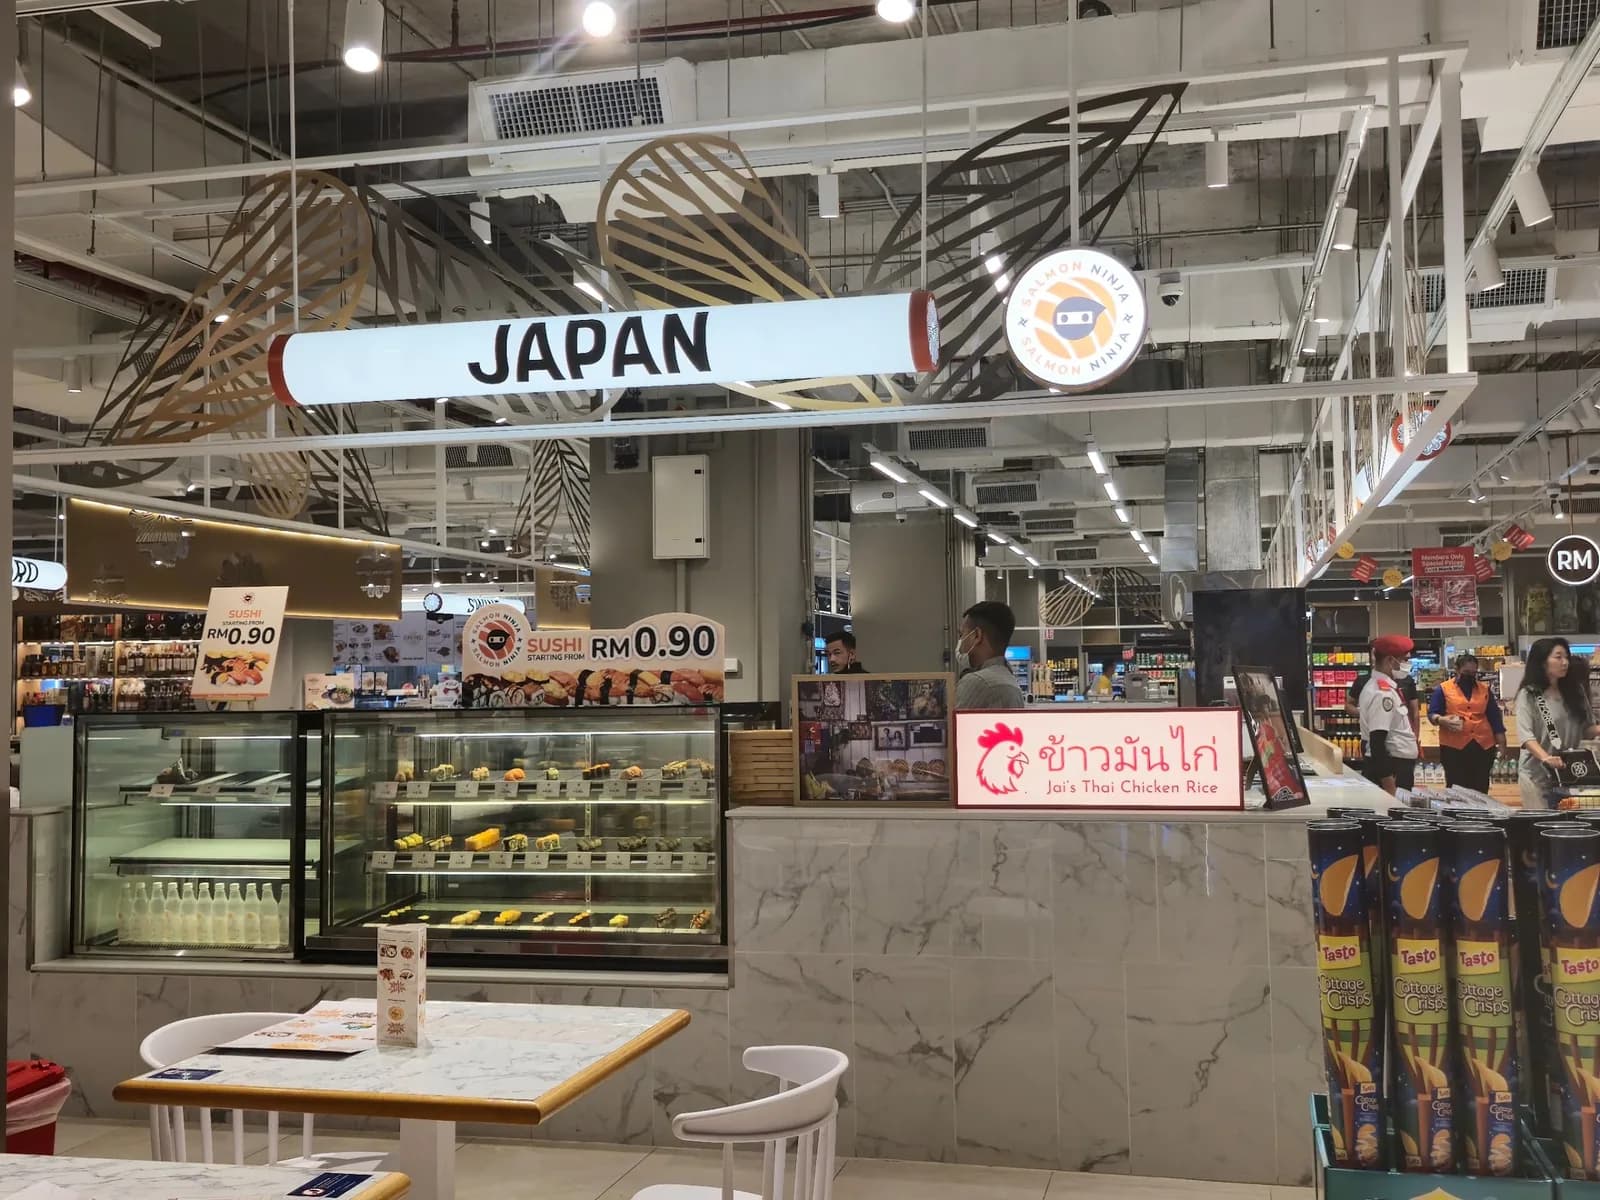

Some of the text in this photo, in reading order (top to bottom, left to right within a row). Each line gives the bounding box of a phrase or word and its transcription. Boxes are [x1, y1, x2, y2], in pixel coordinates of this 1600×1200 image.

[1022, 261, 1130, 307] SALMON NINJA
[468, 312, 711, 384] JAPAN
[1022, 332, 1131, 376] SALMON NINJA
[1557, 549, 1592, 571] RM
[228, 609, 262, 619] SUSHI
[472, 612, 521, 634] SALMON NINJA
[207, 627, 276, 645] RM0.90
[527, 637, 582, 653] SUSHI
[591, 625, 716, 659] RM0.90
[472, 646, 521, 667] SALMON NINJA
[527, 653, 586, 662] STARTING FROM
[1039, 725, 1218, 772] ข้าวมันไก่
[1046, 779, 1218, 795] Jai's Thai Chicken Rice
[1322, 945, 1356, 961] Tasto
[1401, 949, 1437, 965] Tasto
[1460, 951, 1495, 967] Tasto
[1561, 959, 1599, 975] Tasto
[1393, 976, 1442, 998] Cottage
[1553, 986, 1600, 1009] Cottag
[1566, 1004, 1600, 1026] Cris
